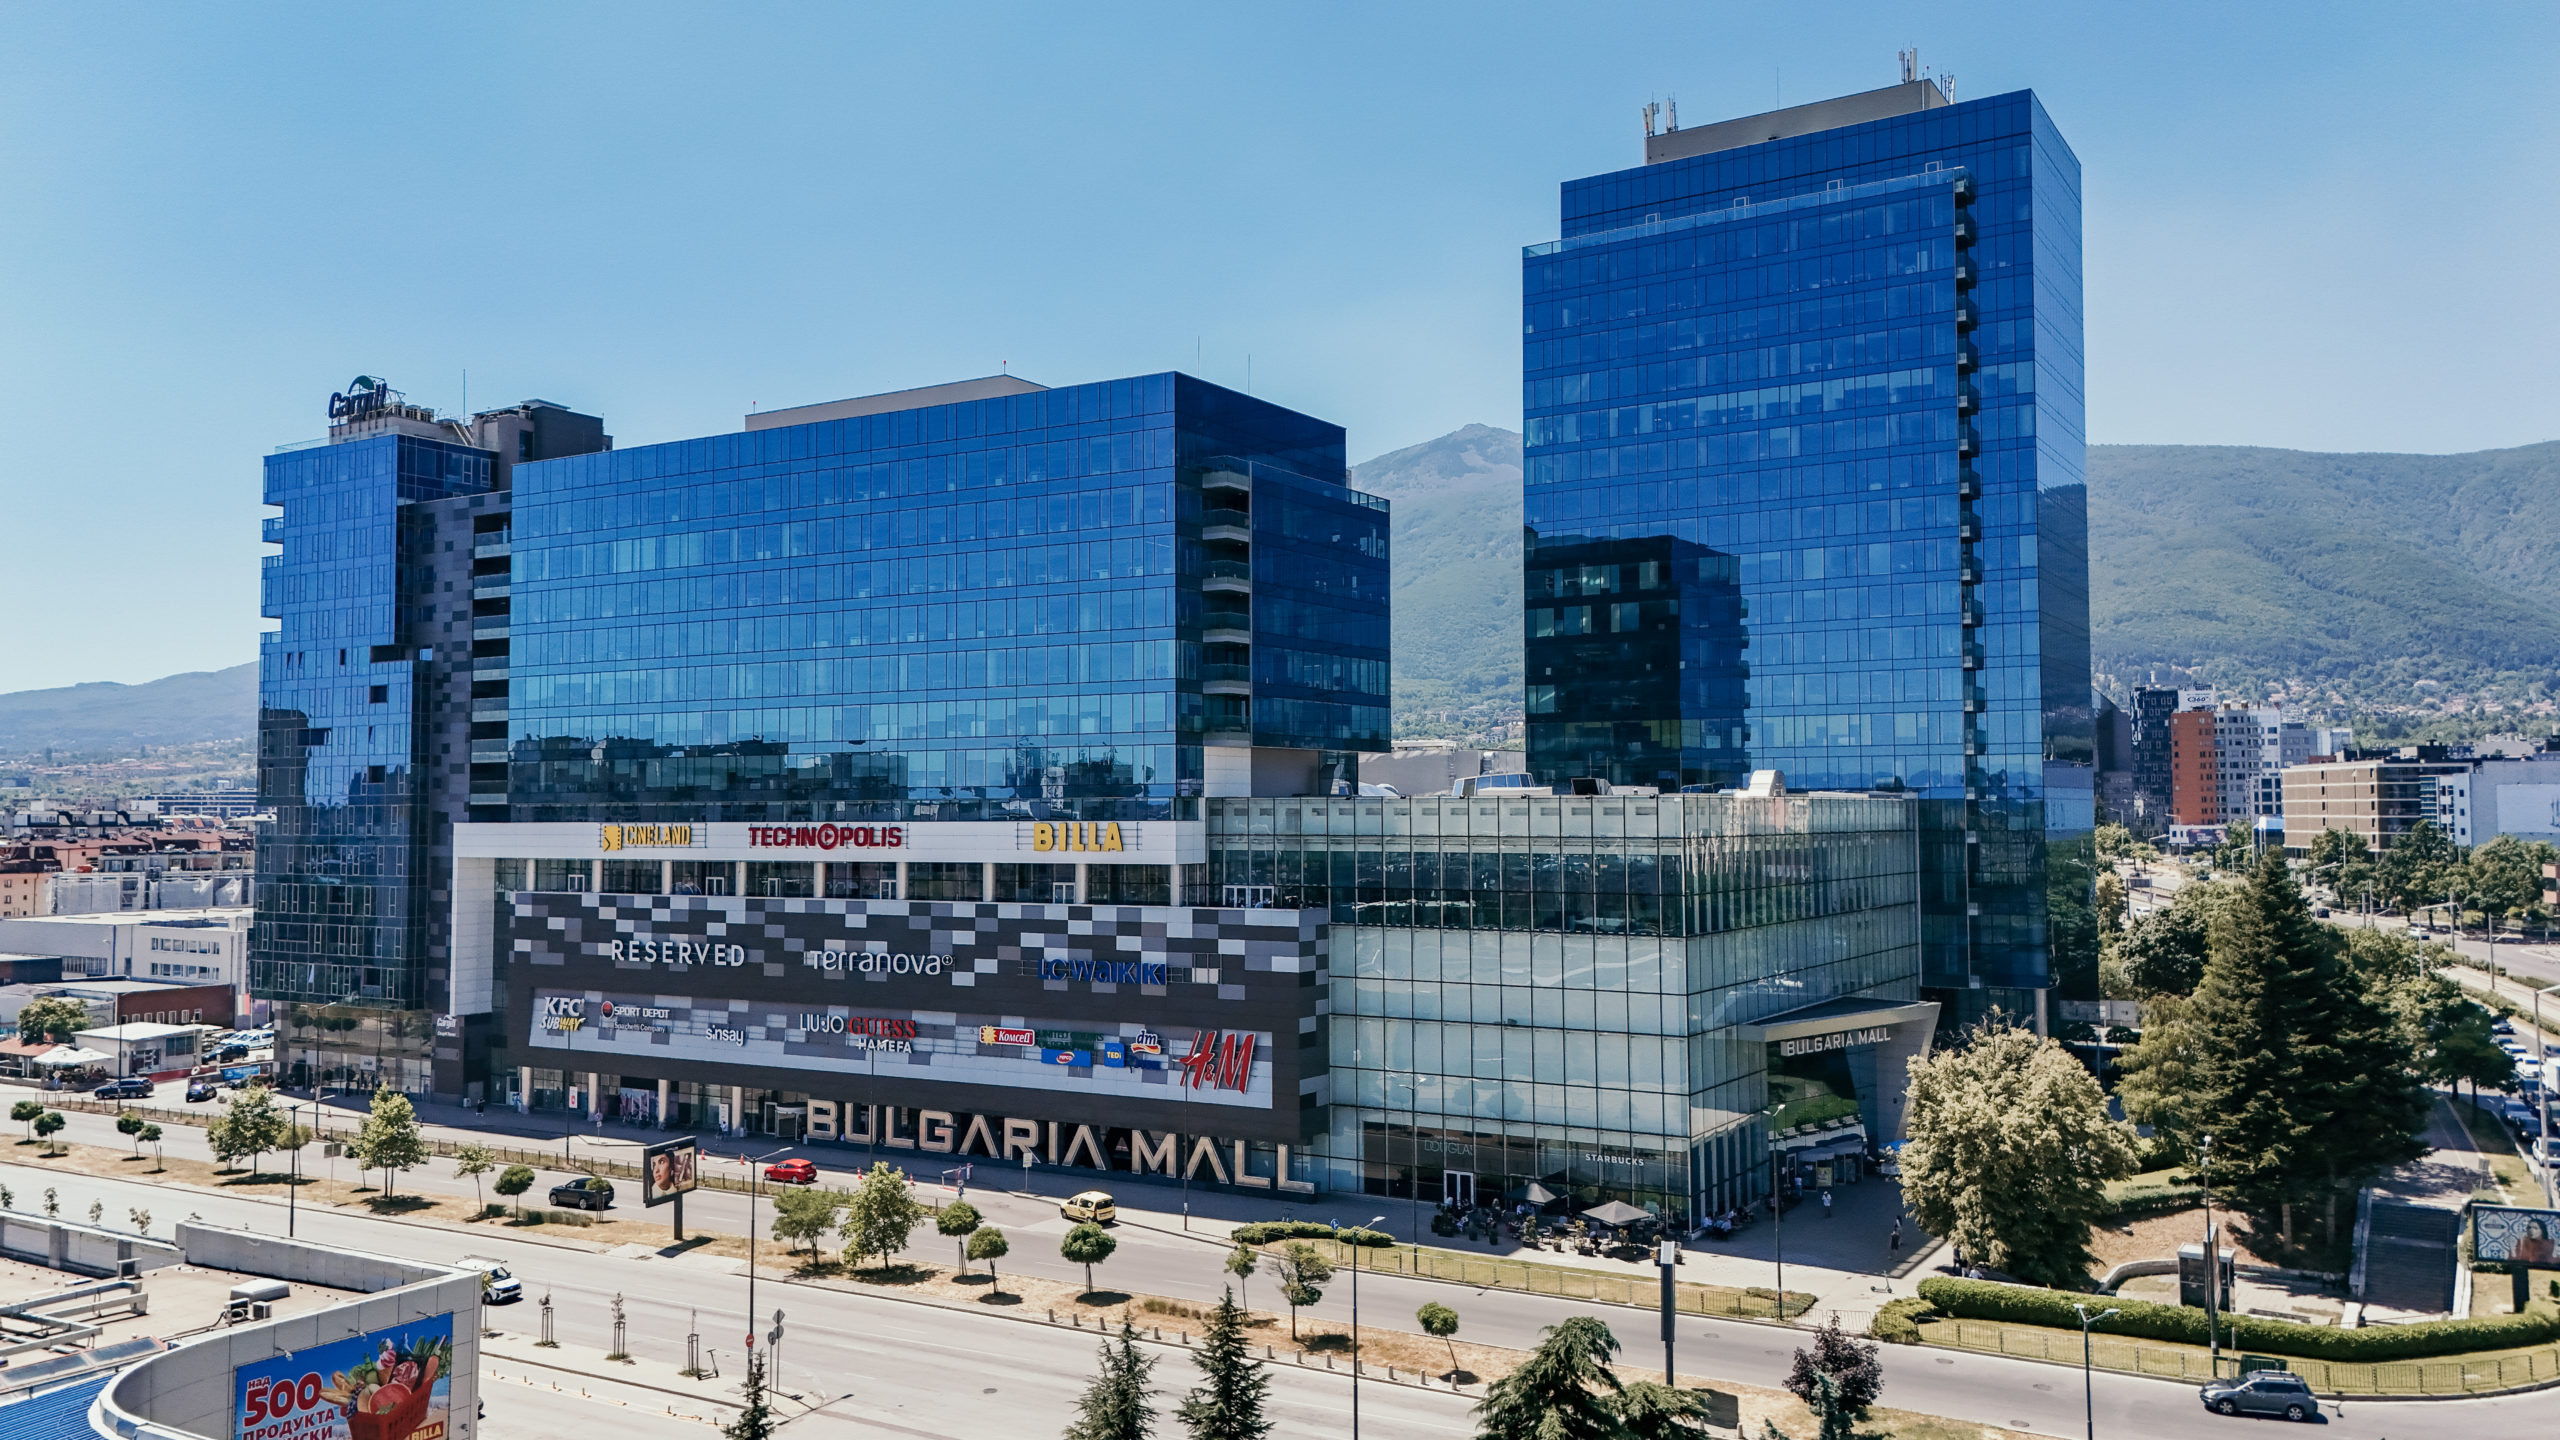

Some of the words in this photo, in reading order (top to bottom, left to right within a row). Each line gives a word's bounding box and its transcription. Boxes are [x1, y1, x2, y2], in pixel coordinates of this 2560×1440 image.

[625, 825, 691, 846] CINELAND
[748, 823, 902, 850] TECHNOPOLIS
[1033, 822, 1124, 852] BILLA
[610, 939, 745, 967] RESERVED
[1038, 958, 1068, 981] LC
[544, 996, 581, 1017] KFC
[614, 1006, 641, 1017] SPORT
[643, 1008, 670, 1019] DEPOT
[540, 1015, 586, 1032] SUBWAY
[849, 1016, 916, 1039] GUESS
[705, 1024, 744, 1047] sinsay
[858, 1038, 913, 1054] HAMEFA
[1137, 1030, 1158, 1045] dm
[1786, 1032, 1854, 1057] BULGARIA
[1859, 1027, 1891, 1046] MALL
[1180, 1030, 1256, 1094] H&M
[807, 1098, 1107, 1172] BULGARIA
[1132, 1129, 1315, 1195] MALL
[1586, 1153, 1645, 1167] STARBUCKS
[247, 1376, 271, 1390] над
[243, 1372, 323, 1427] 500
[242, 1408, 335, 1440] ПРОДУКТА
[412, 1424, 442, 1440] BILLA
